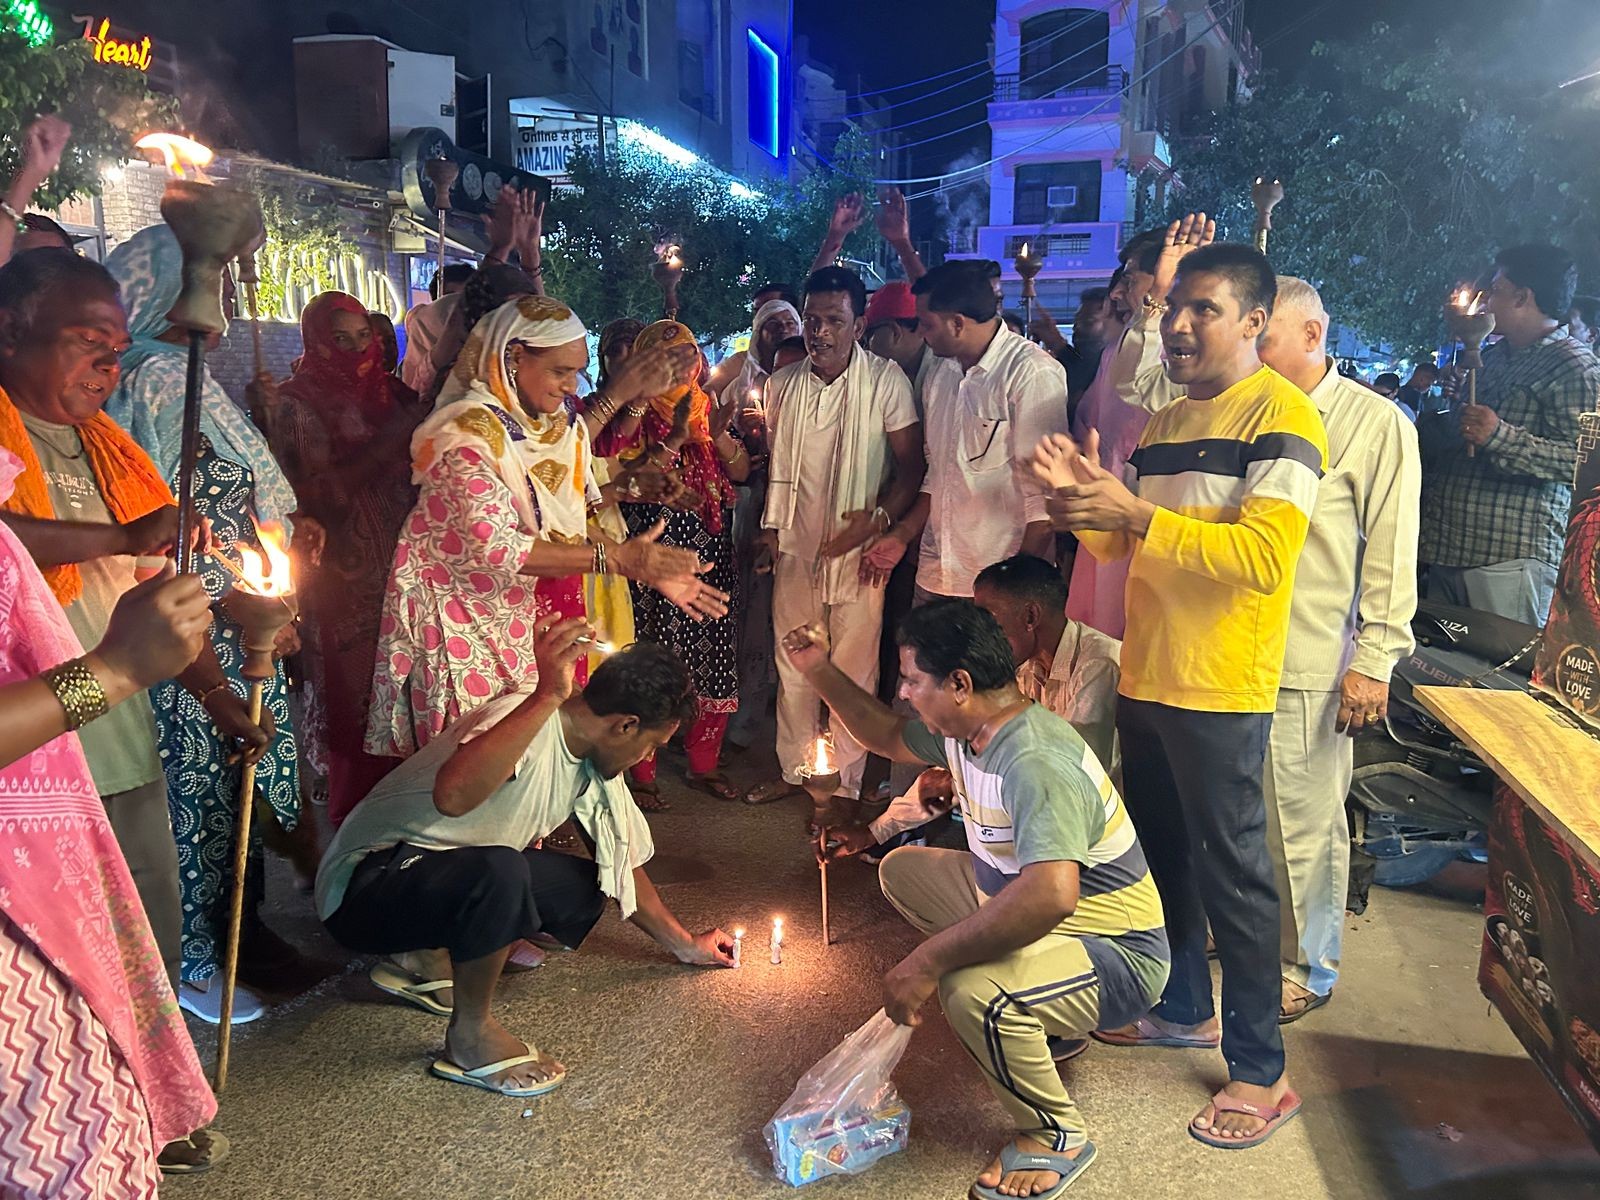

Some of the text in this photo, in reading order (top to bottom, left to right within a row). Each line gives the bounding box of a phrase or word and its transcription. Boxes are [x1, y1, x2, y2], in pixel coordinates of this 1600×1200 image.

[522, 131, 558, 143] Online
[1565, 655, 1594, 674] MADE
[1570, 669, 1590, 685] WITH
[1565, 680, 1592, 700] LOVE
[1507, 879, 1533, 905] MADE
[1509, 897, 1532, 923] LOVE
